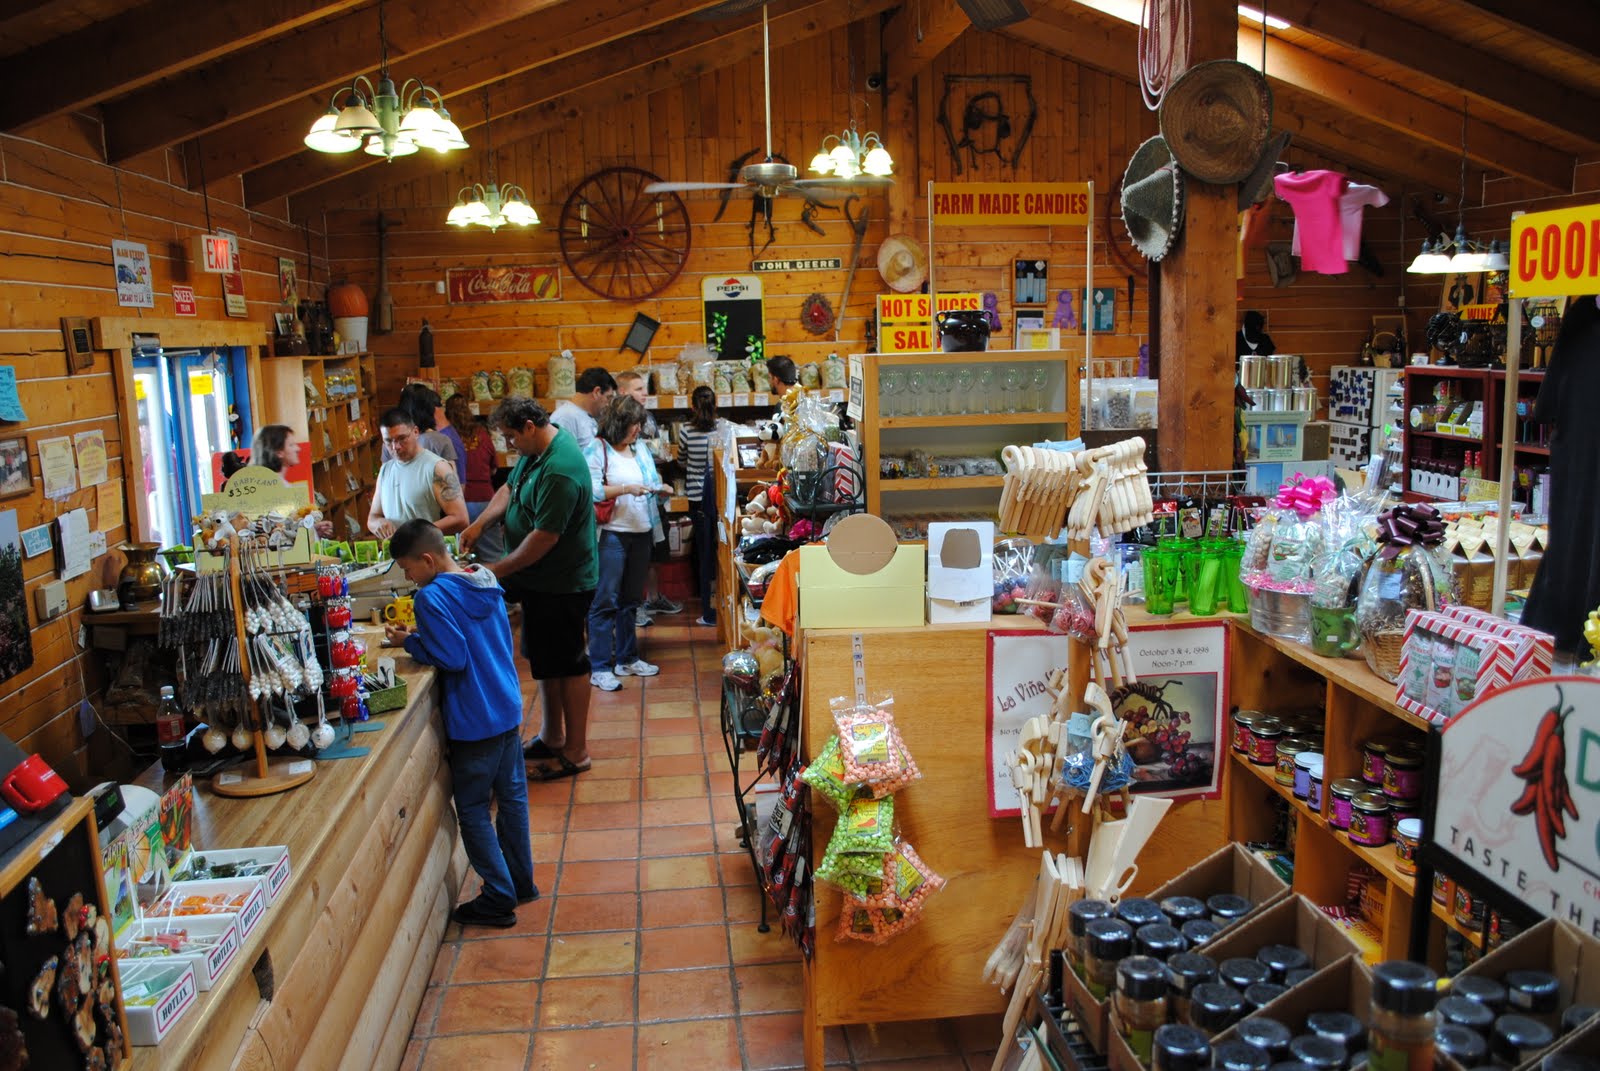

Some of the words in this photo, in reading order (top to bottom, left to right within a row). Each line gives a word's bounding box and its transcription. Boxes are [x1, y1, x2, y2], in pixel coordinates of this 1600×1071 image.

[934, 193, 974, 215] FARM
[979, 193, 1020, 215] MADE
[1024, 193, 1088, 215] CANDIES
[206, 238, 229, 270] EXIT
[759, 261, 791, 270] JOHN
[796, 260, 835, 269] DEERE
[881, 299, 916, 318] HOT
[1467, 307, 1497, 321] WINE
[228, 486, 257, 497] $3.50
[1139, 648, 1169, 657] October
[997, 695, 1016, 712] La
[1014, 680, 1046, 702] Viña
[271, 865, 288, 892] HOTLIX
[1450, 825, 1528, 892] TASTE
[1550, 889, 1600, 940] THE
[243, 902, 261, 929] HOTLIX
[212, 939, 234, 970] HOTLIX
[161, 987, 189, 1021] HOTLIX
